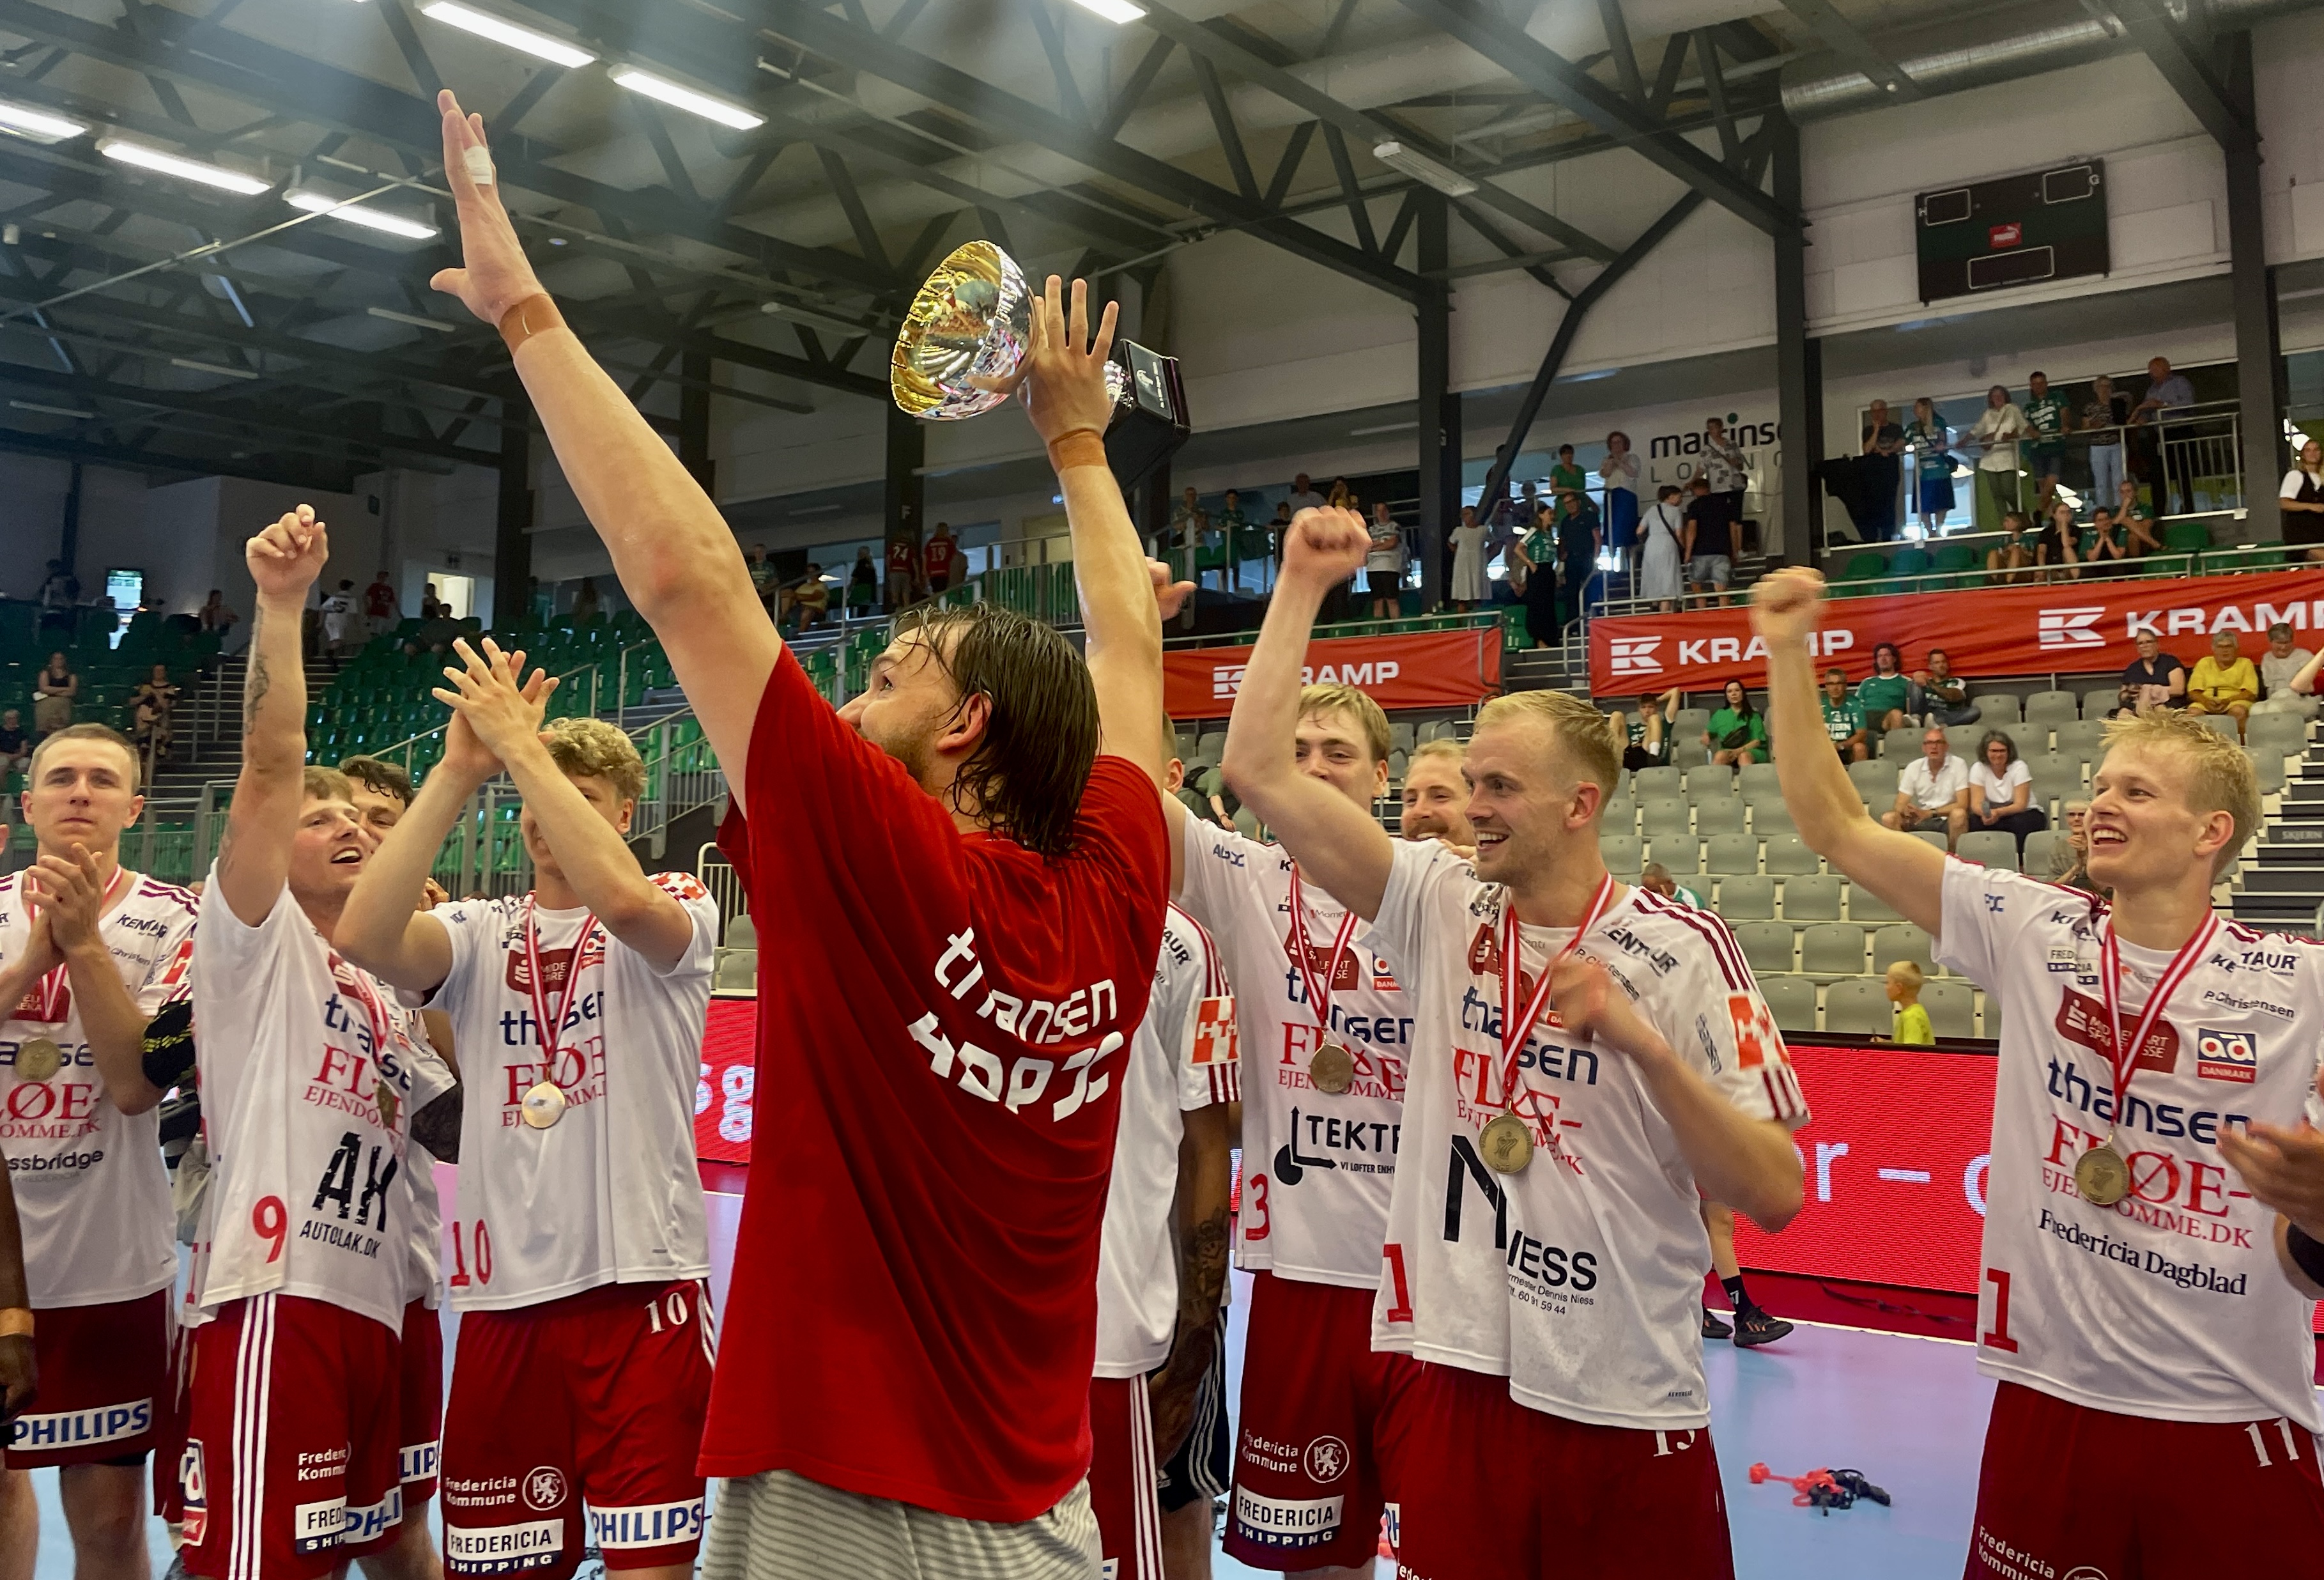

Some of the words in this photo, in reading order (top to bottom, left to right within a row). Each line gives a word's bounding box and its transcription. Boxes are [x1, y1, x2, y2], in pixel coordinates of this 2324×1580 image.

[1651, 413, 1781, 459] marins
[1300, 661, 1399, 685] RAMP
[2210, 951, 2297, 973] KETAUR
[2201, 1066, 2252, 1080] DANMARK
[8, 1150, 104, 1171] ssbridge
[252, 1195, 288, 1264] 9
[299, 1220, 382, 1259] AUTOLAK.DK
[450, 1219, 492, 1287] 10
[2038, 1208, 2141, 1269] Fredericia
[2144, 1250, 2247, 1296] Dagblad
[1509, 1273, 1537, 1292] rmester
[1537, 1285, 1568, 1302] Dennis
[1518, 1290, 1530, 1302] 60
[1541, 1301, 1553, 1312] 59
[1553, 1306, 1566, 1315] 44
[644, 1292, 688, 1334] 10
[2244, 1417, 2300, 1468] 11
[590, 1503, 702, 1542] PHILIPS
[1238, 1496, 1333, 1526] FREDERICIA
[450, 1529, 551, 1553] FREDERICIA
